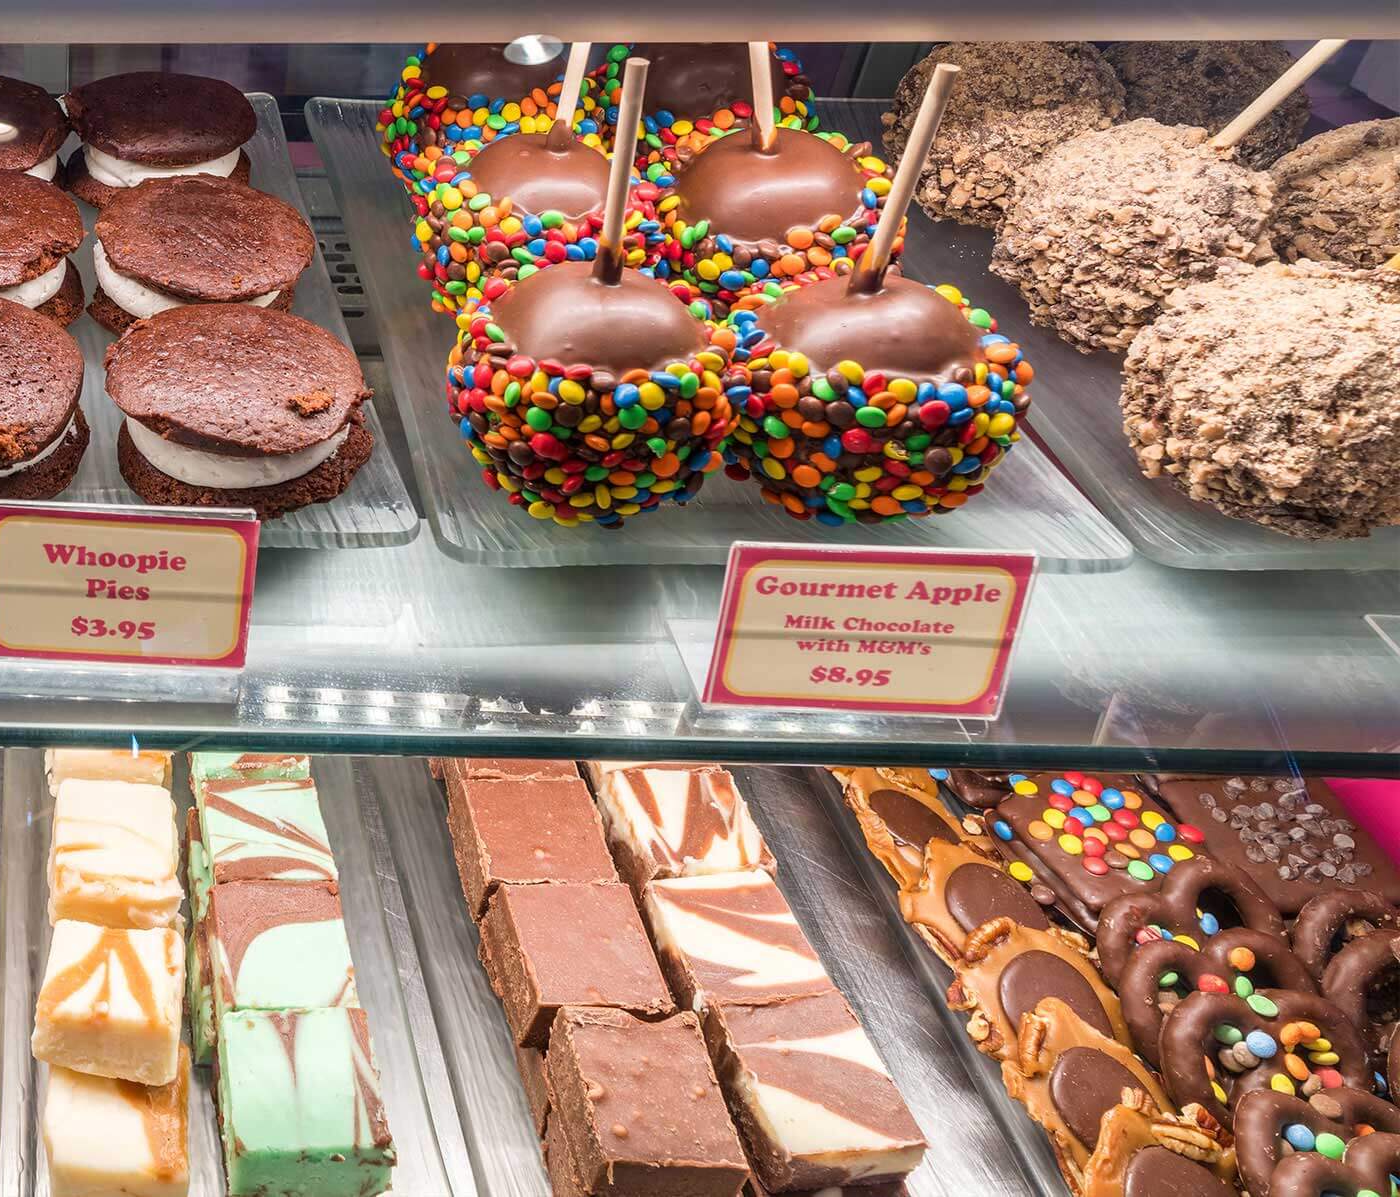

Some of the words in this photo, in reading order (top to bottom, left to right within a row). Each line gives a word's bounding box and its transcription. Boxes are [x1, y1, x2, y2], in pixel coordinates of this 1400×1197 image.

[43, 543, 186, 574] Whoopie
[87, 577, 149, 601] Pies
[755, 575, 897, 601] Gourmet
[904, 580, 1000, 606] Apple
[72, 616, 156, 640] $3.95
[784, 612, 835, 631] Milk
[842, 617, 954, 634] Chocolate
[797, 638, 850, 653] with
[857, 639, 932, 656] M&M's
[811, 665, 891, 687] $8.95
